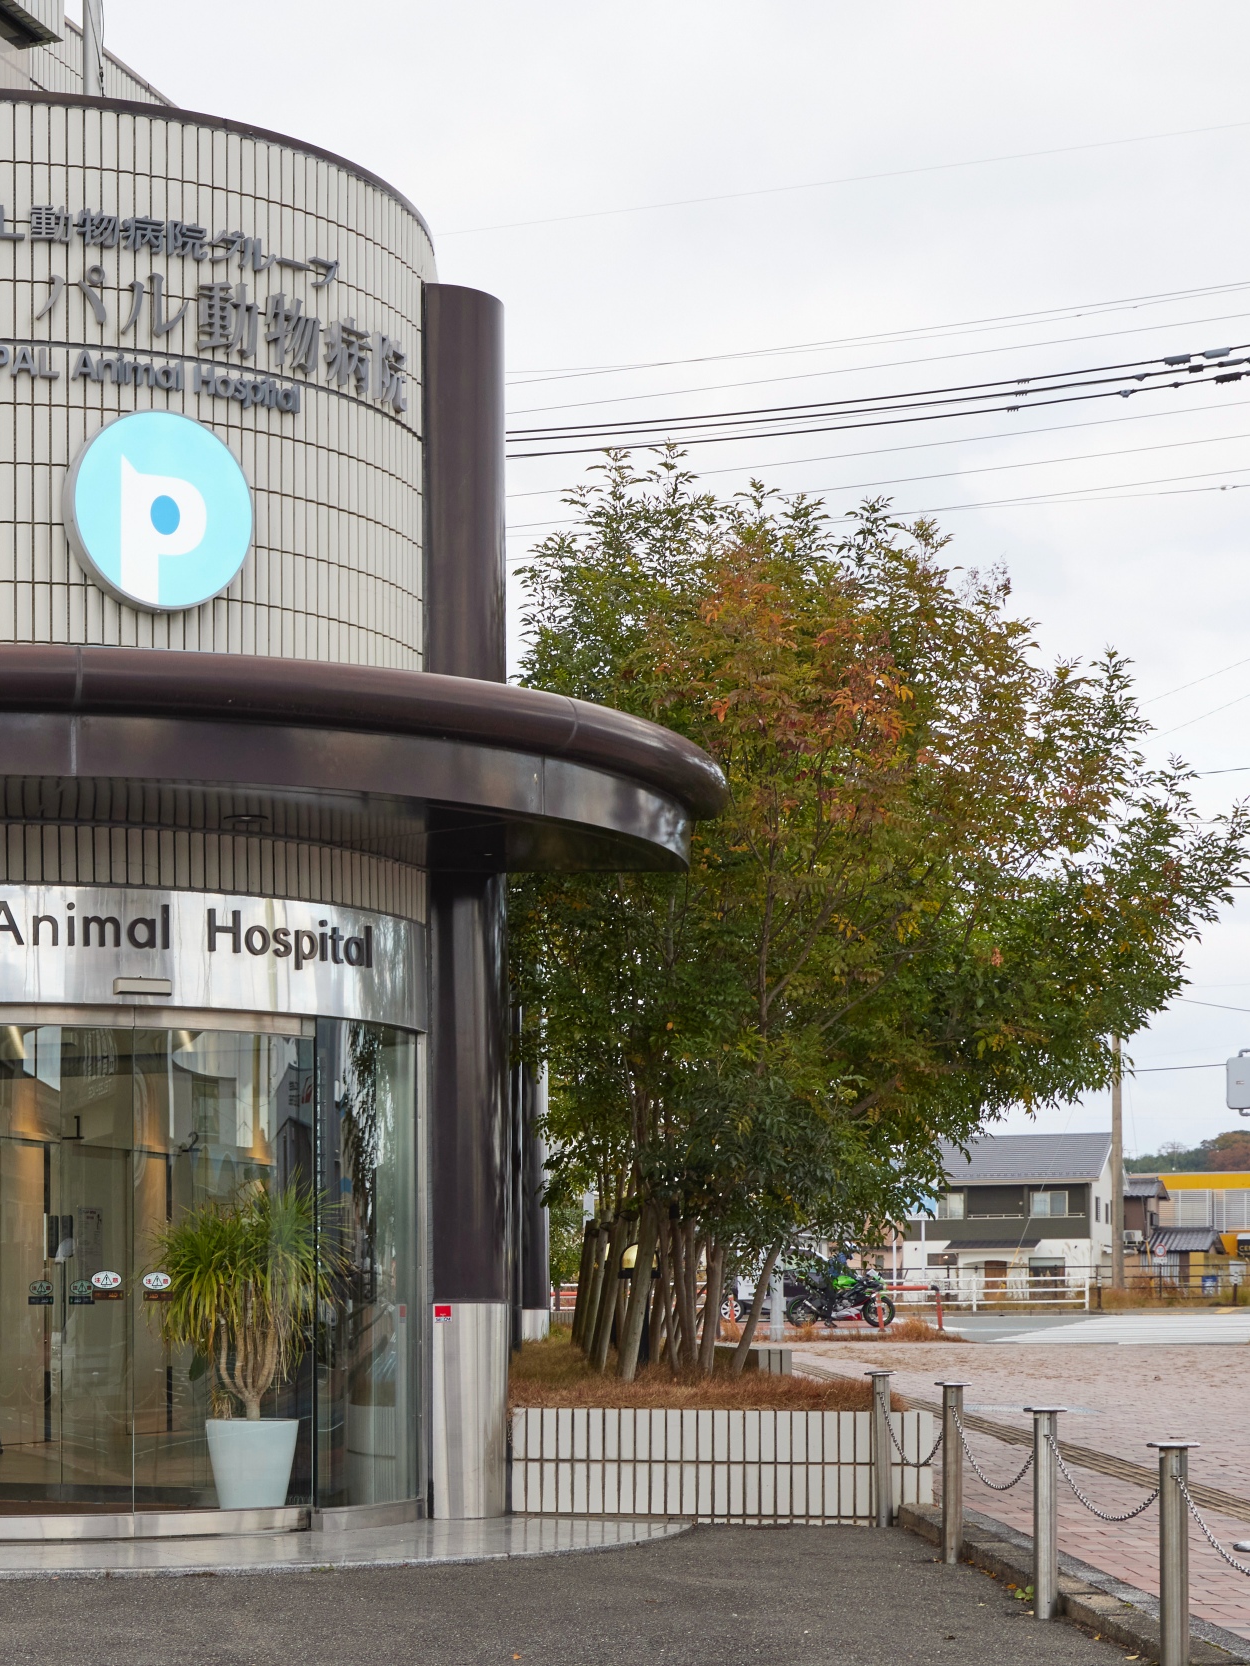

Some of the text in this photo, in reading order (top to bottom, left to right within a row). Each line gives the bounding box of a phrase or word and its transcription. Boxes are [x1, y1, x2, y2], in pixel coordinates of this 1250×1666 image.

[36, 264, 408, 413] パル動物病院
[71, 350, 184, 392] Animal
[193, 363, 301, 414] Hospital
[207, 908, 374, 970] Hospital
